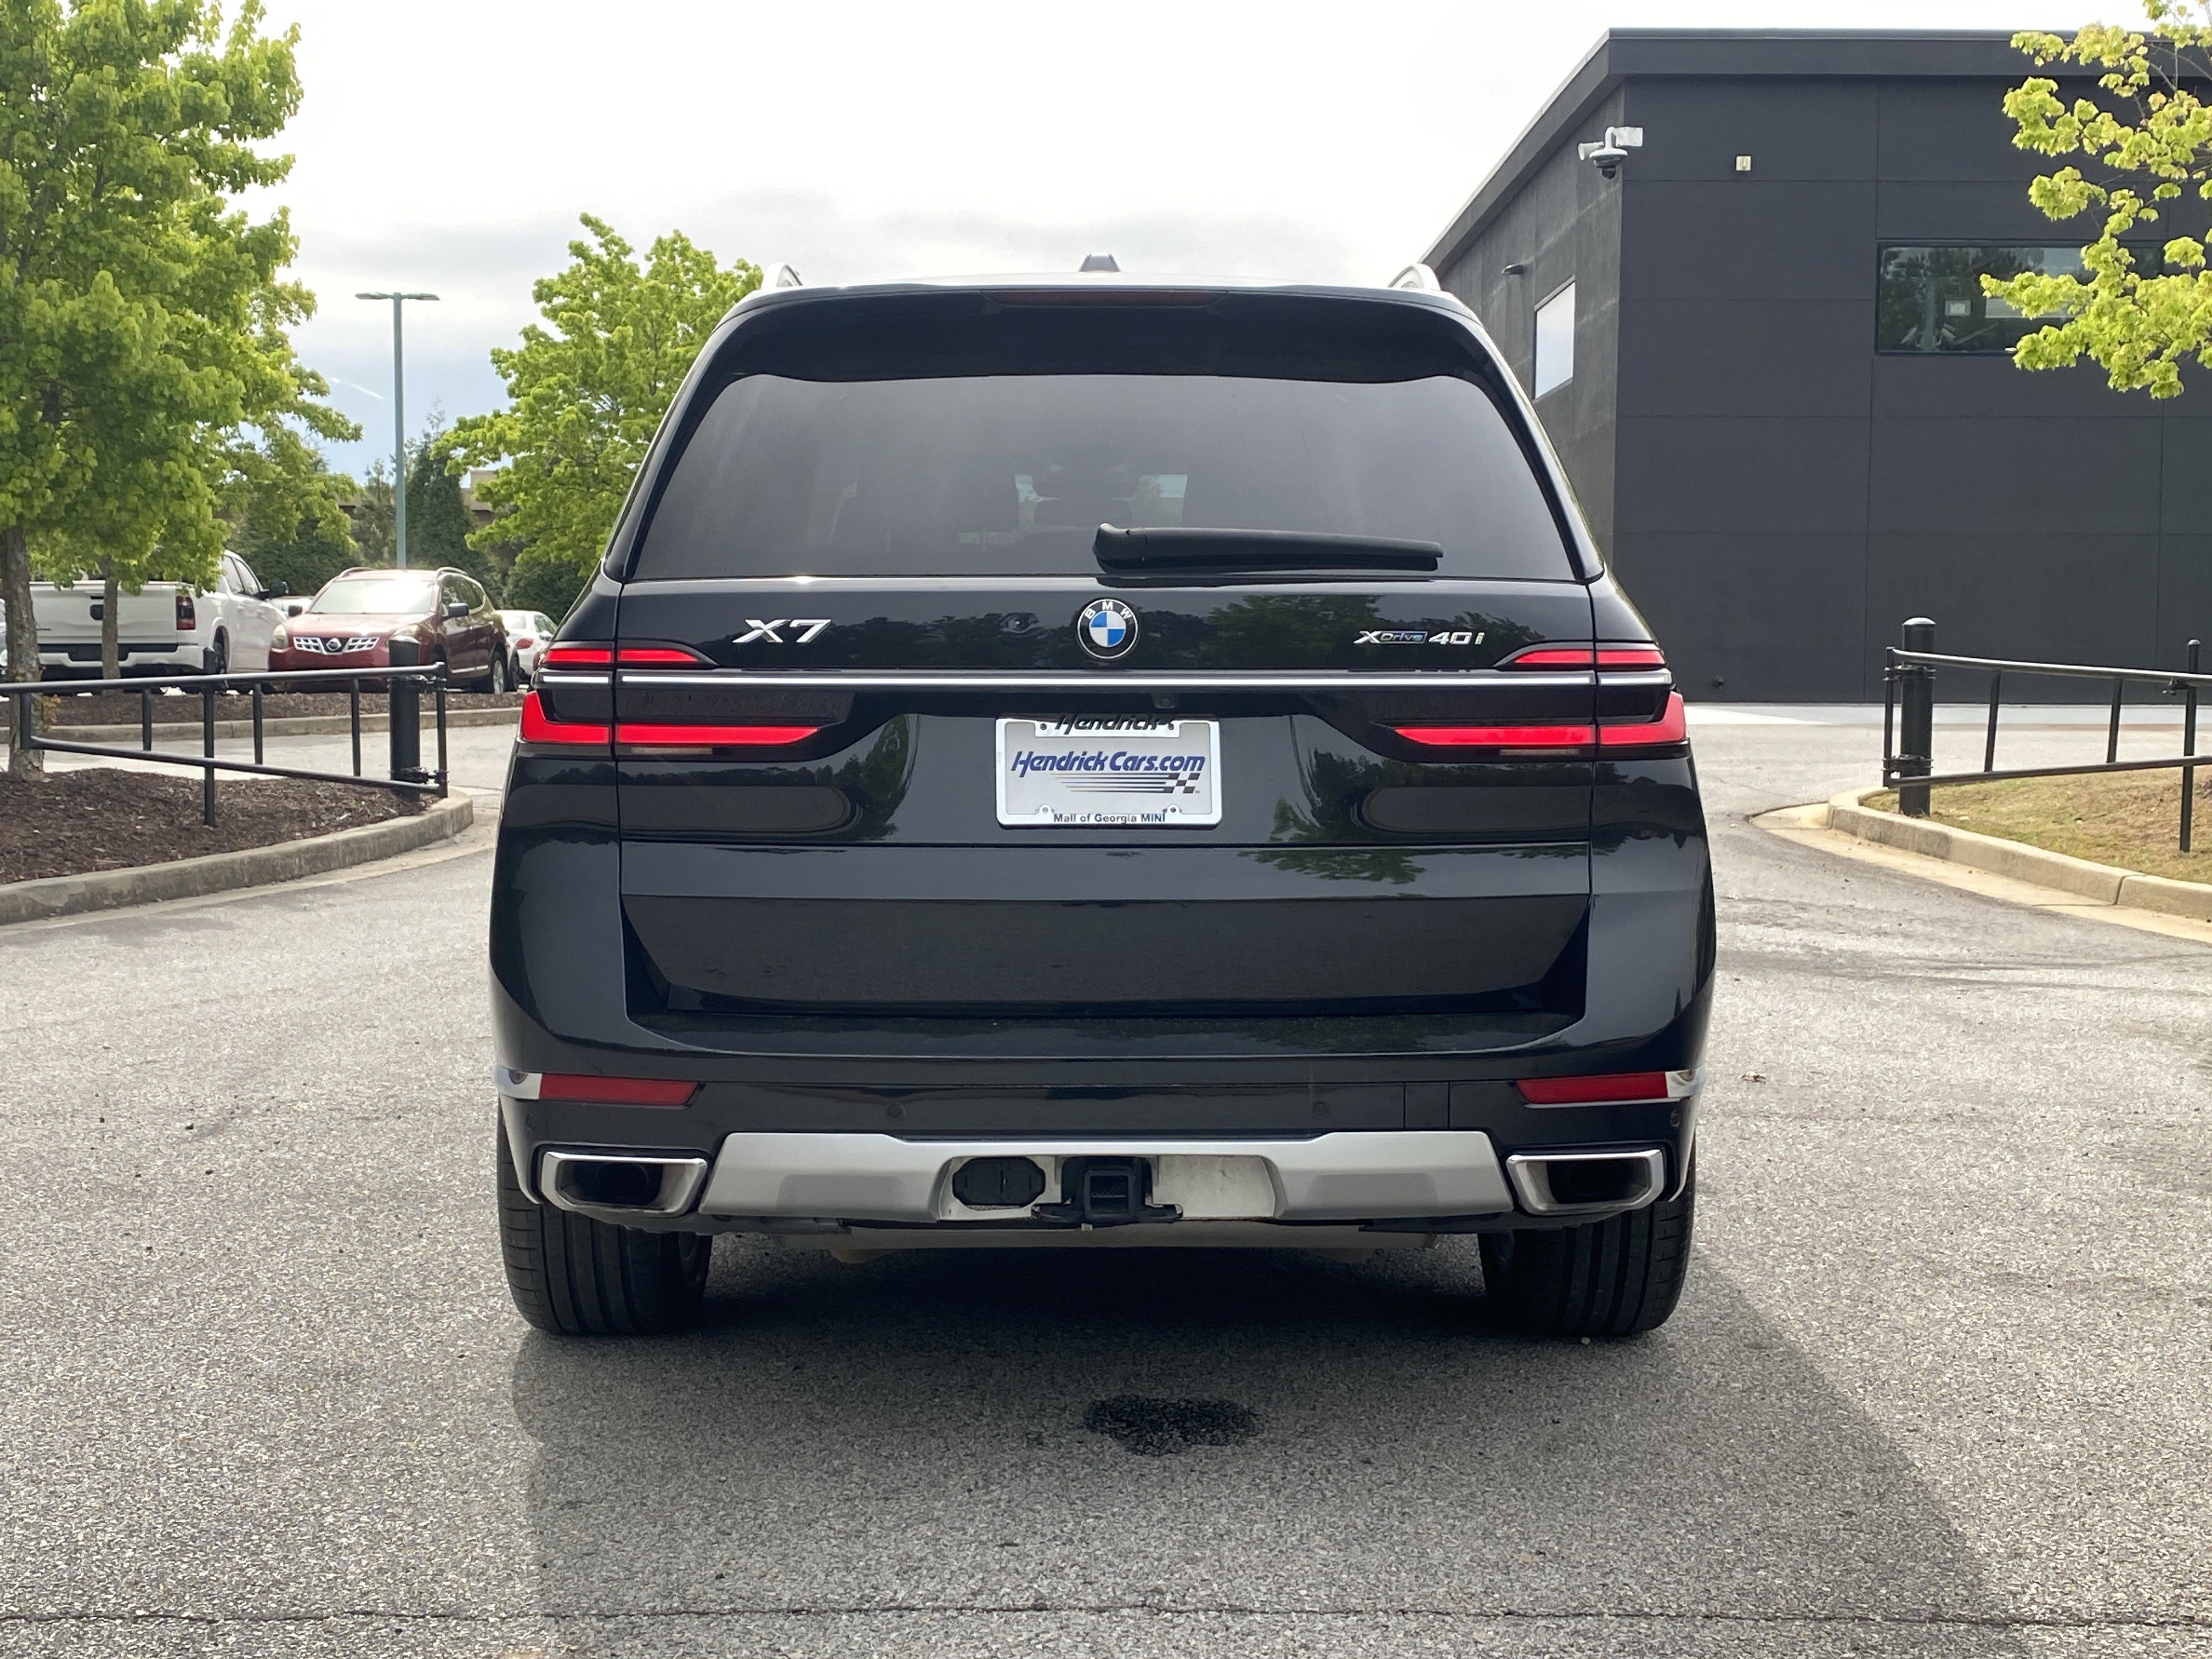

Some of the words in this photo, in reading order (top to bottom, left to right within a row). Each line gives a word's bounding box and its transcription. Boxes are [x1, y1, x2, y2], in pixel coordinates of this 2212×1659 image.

[1084, 601, 1132, 619] BMW
[732, 619, 832, 643] X7
[1054, 714, 1157, 735] Hendrick
[1053, 813, 1076, 822] Mall
[1080, 813, 1091, 822] of
[1094, 813, 1137, 823] Georgia
[1141, 813, 1165, 822] MINI
